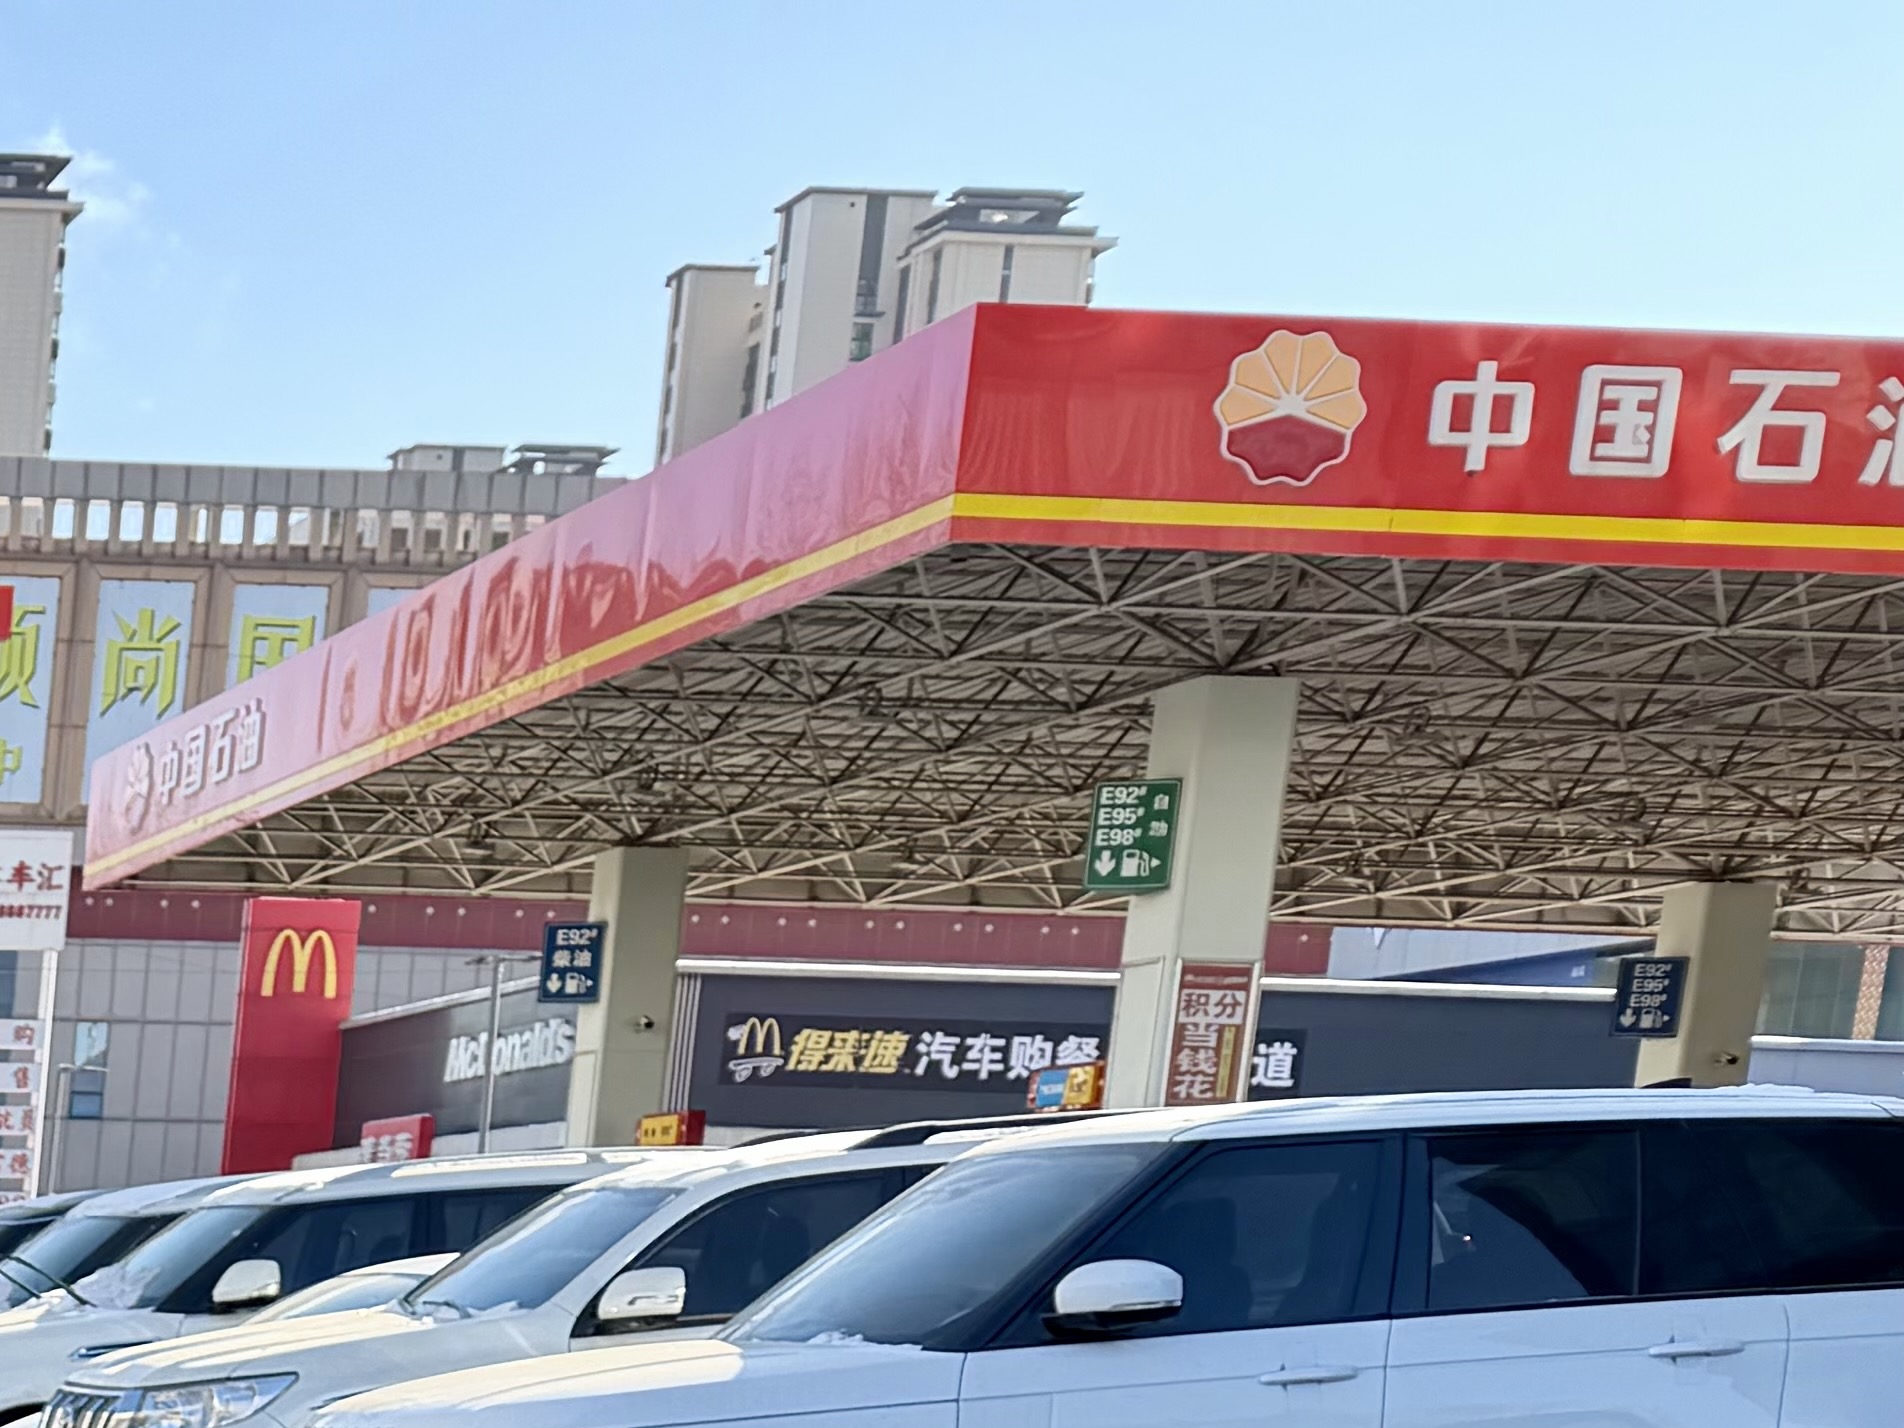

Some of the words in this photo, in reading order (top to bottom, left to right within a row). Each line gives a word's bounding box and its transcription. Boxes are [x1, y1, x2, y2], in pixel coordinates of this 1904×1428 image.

[159, 698, 266, 806] 中国石油
[1181, 991, 1243, 1019] 积分
[784, 1027, 911, 1075] 得来速
